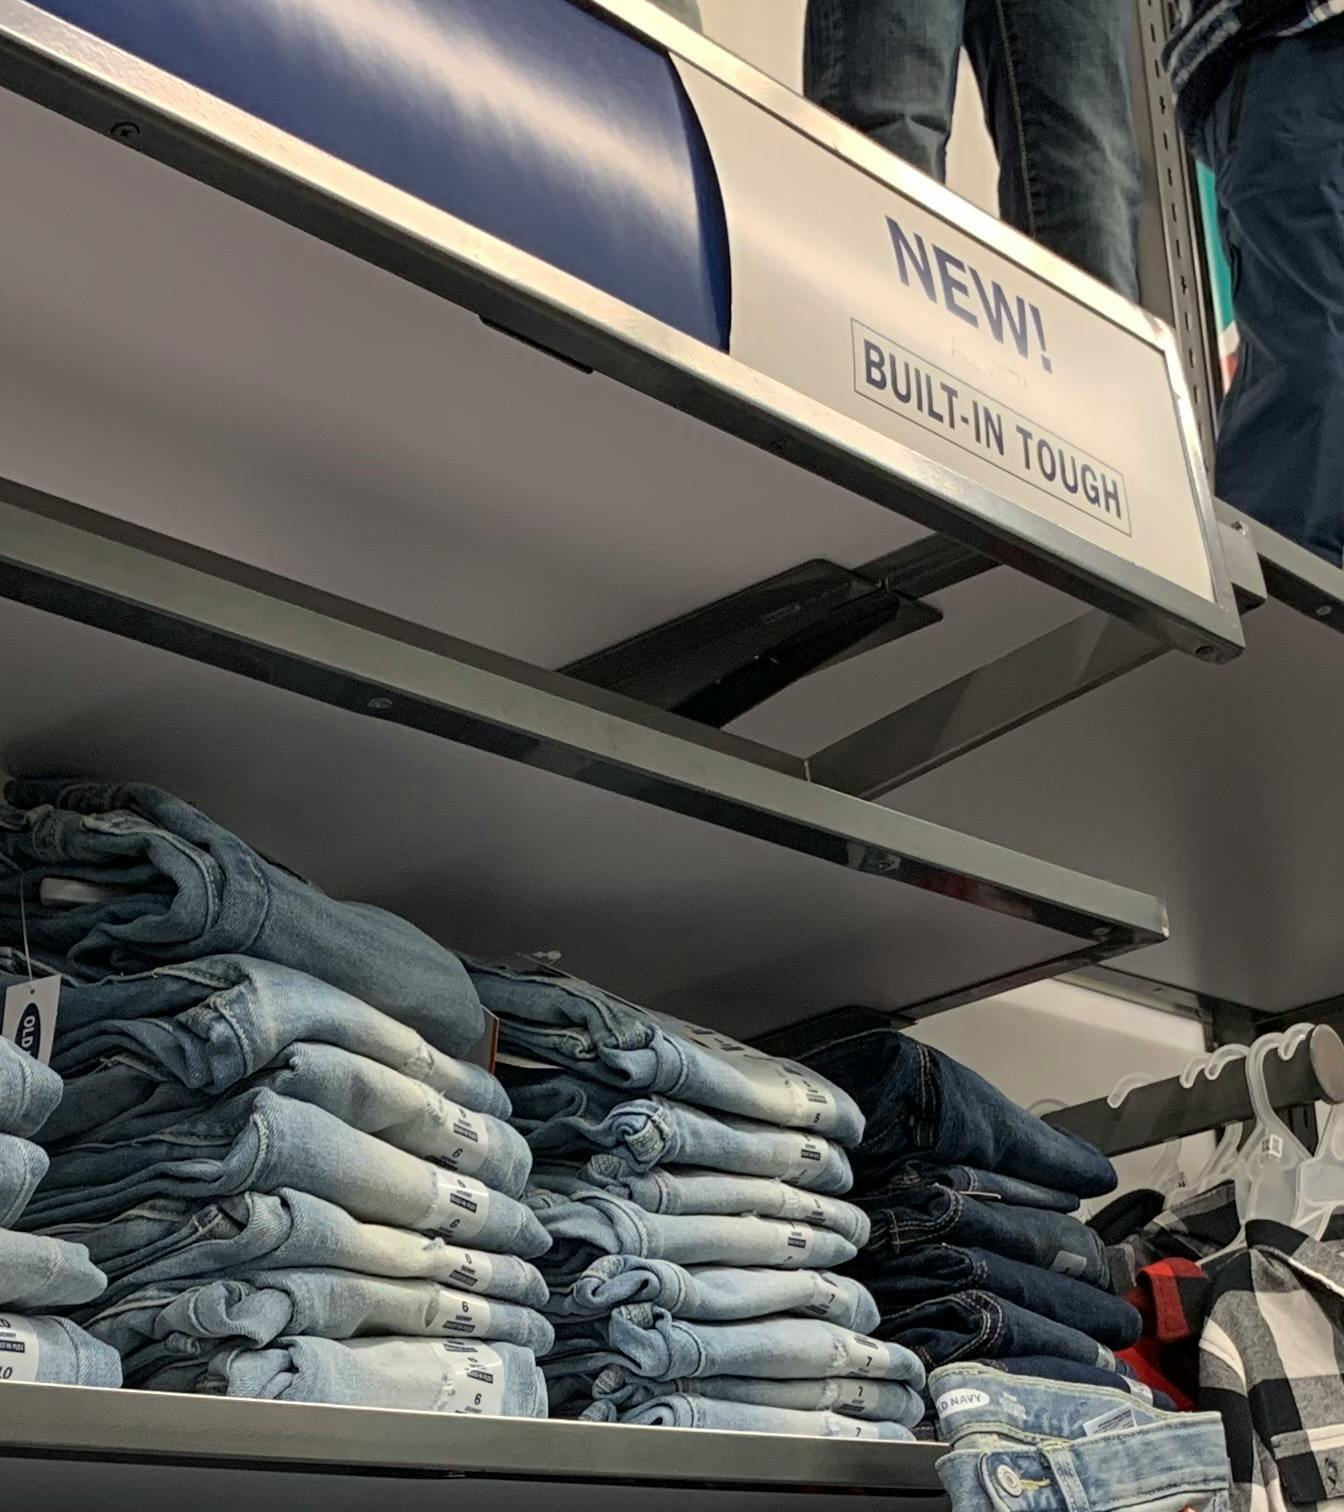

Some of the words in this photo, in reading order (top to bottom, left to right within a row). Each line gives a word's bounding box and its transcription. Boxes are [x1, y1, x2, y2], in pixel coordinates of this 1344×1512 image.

[885, 215, 1052, 374] NEW!
[864, 339, 1004, 456] BUILT-IN
[1016, 424, 1122, 519] TOUGH
[22, 1015, 36, 1048] OLD
[462, 1301, 469, 1312] 6
[866, 1356, 873, 1367] 7
[858, 1385, 863, 1397] 7
[474, 1393, 482, 1405] 6
[950, 1394, 981, 1406] NAVY
[856, 1427, 862, 1437] 7
